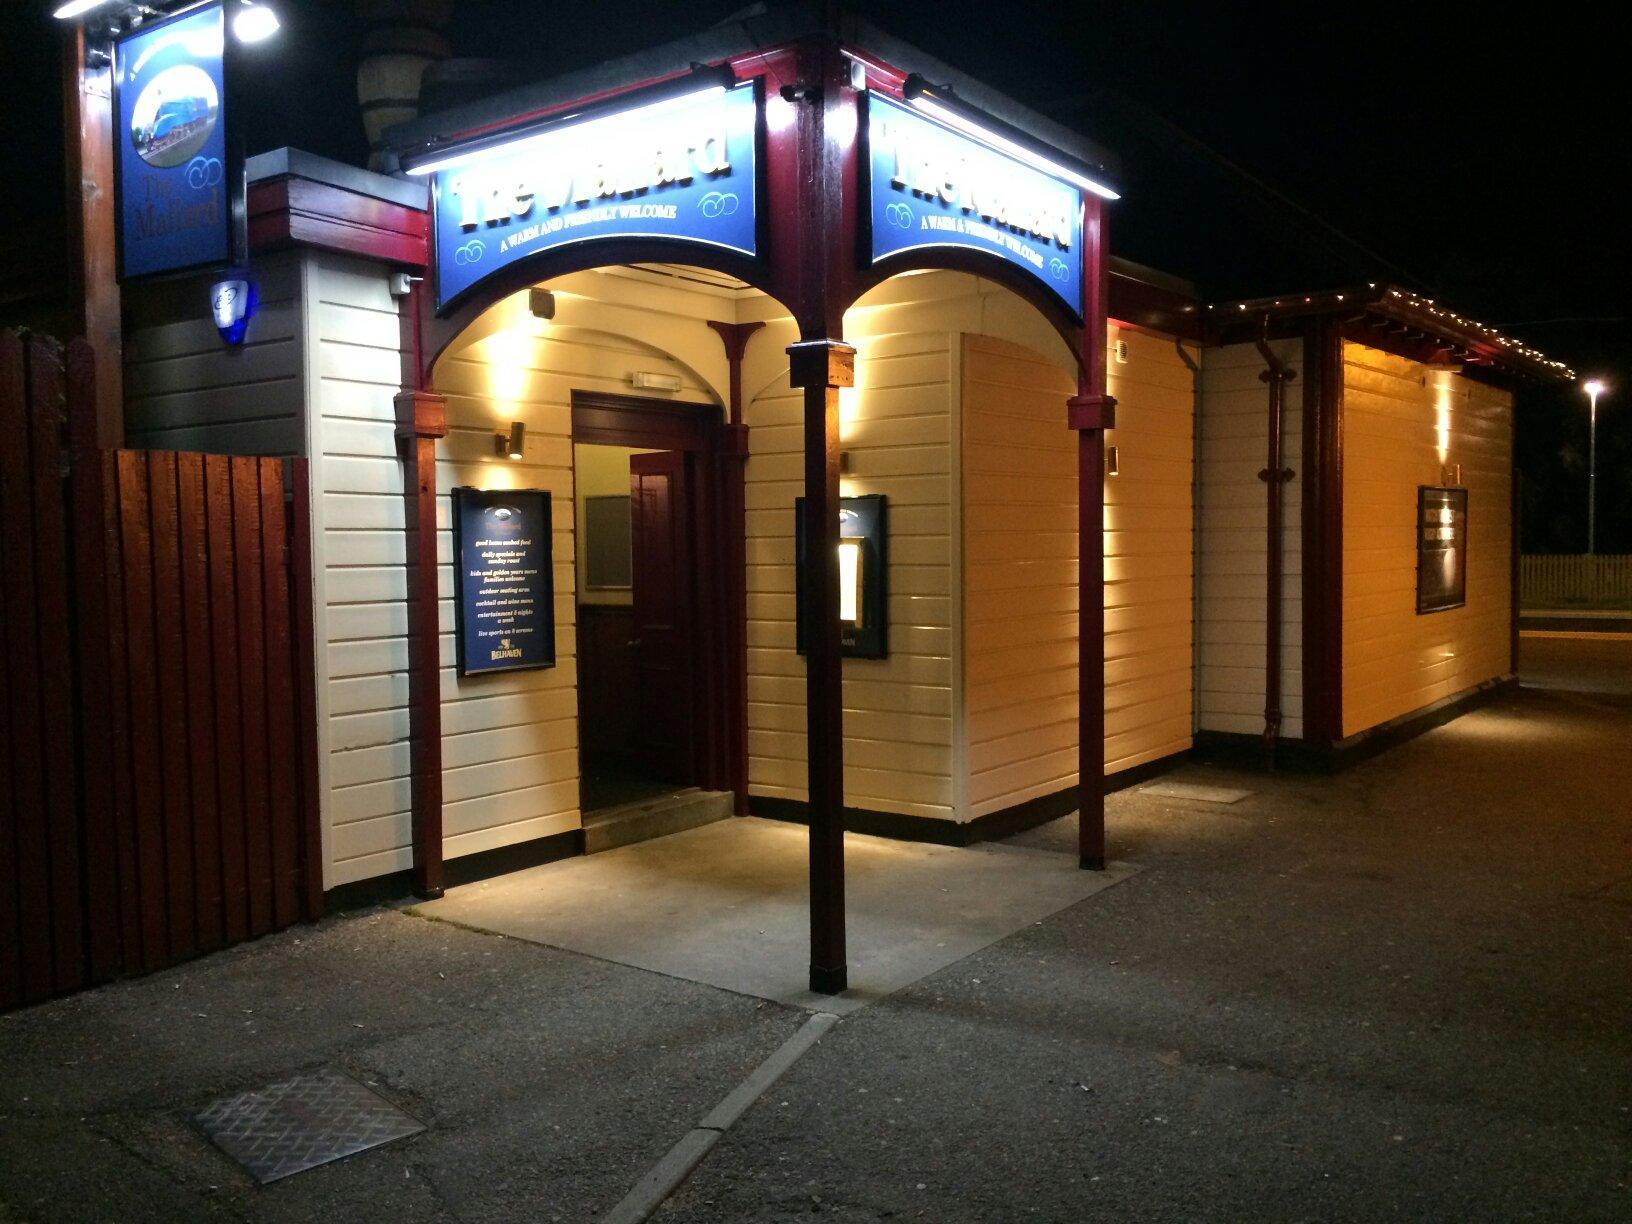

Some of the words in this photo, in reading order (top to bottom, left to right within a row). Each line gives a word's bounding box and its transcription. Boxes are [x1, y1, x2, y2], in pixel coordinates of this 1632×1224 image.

[134, 188, 220, 238] Mallard
[500, 239, 509, 253] A
[508, 225, 540, 248] WARM
[540, 217, 563, 236] AND
[563, 207, 617, 228] FRIENDLY
[619, 204, 678, 219] WELCOME
[920, 215, 929, 230] A
[928, 215, 957, 231] WARM
[1005, 234, 1044, 269] WELCOME
[492, 648, 522, 660] BELHAVEN
